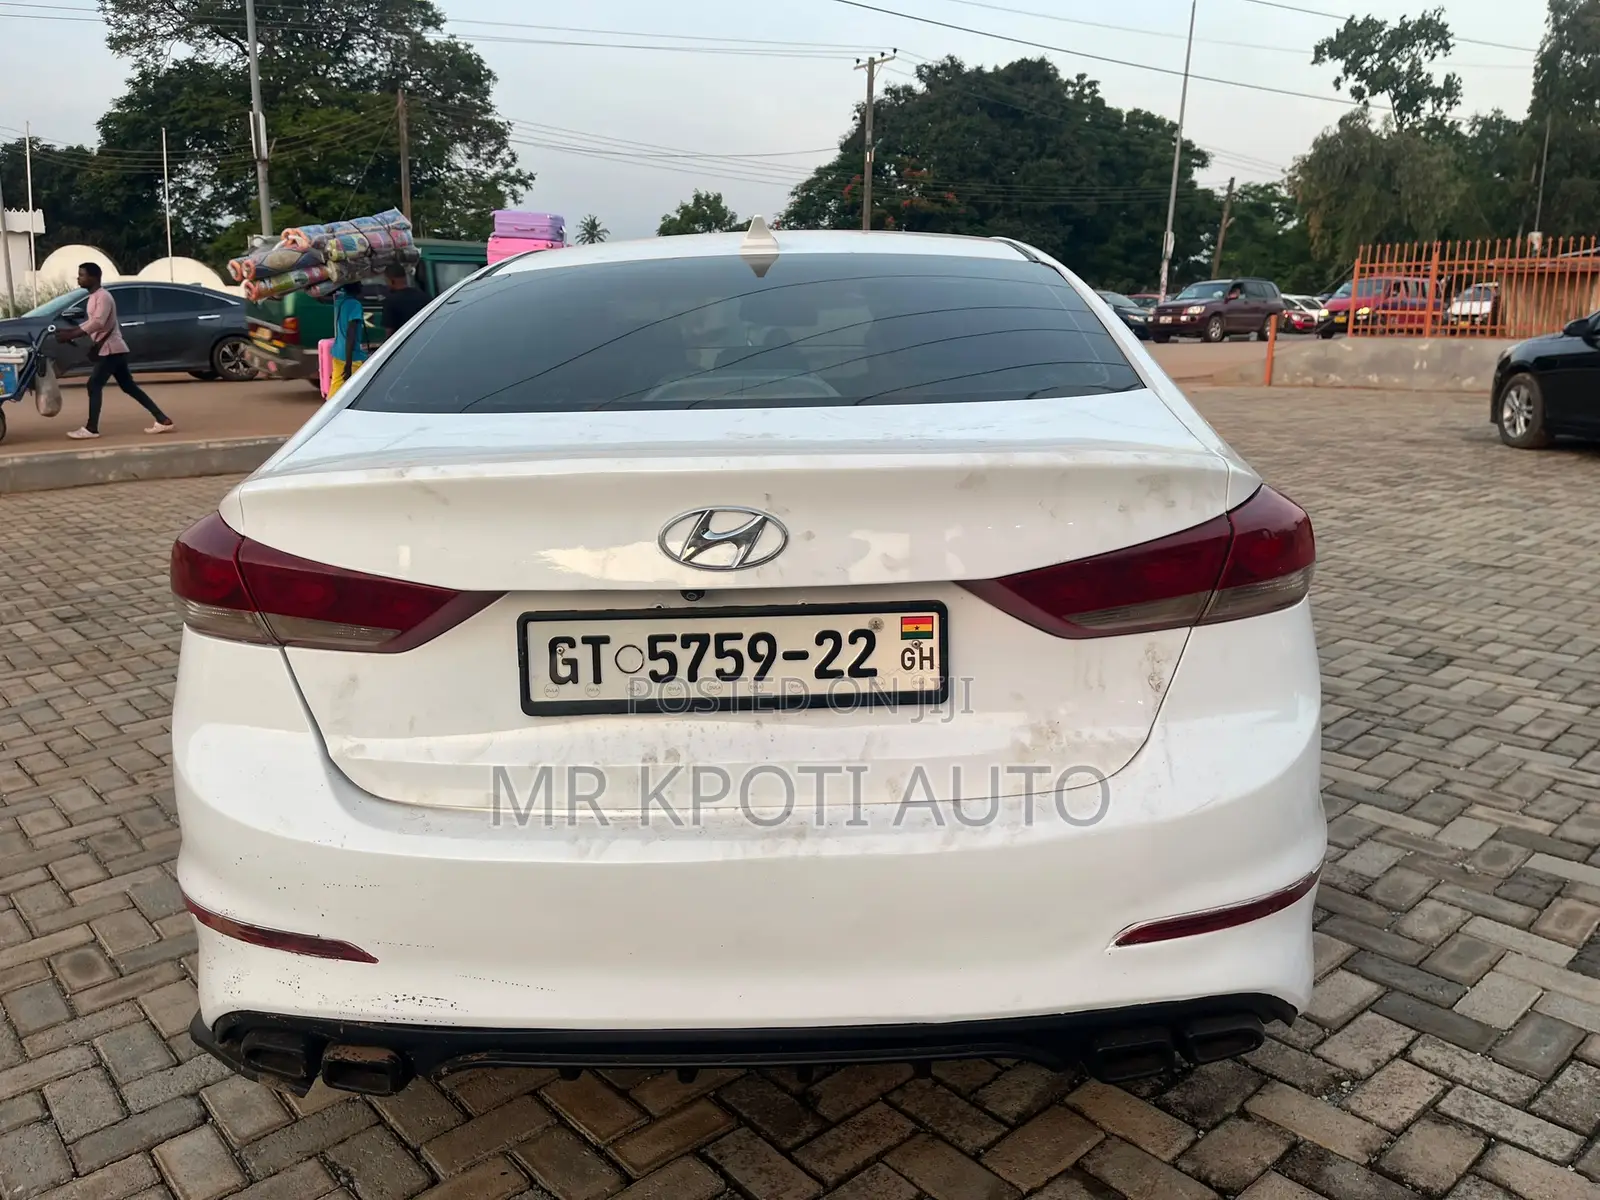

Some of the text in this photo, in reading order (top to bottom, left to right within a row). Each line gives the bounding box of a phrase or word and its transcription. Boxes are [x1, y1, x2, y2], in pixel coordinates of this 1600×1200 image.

[548, 629, 878, 685] GT 5759-22
[900, 646, 934, 671] GH
